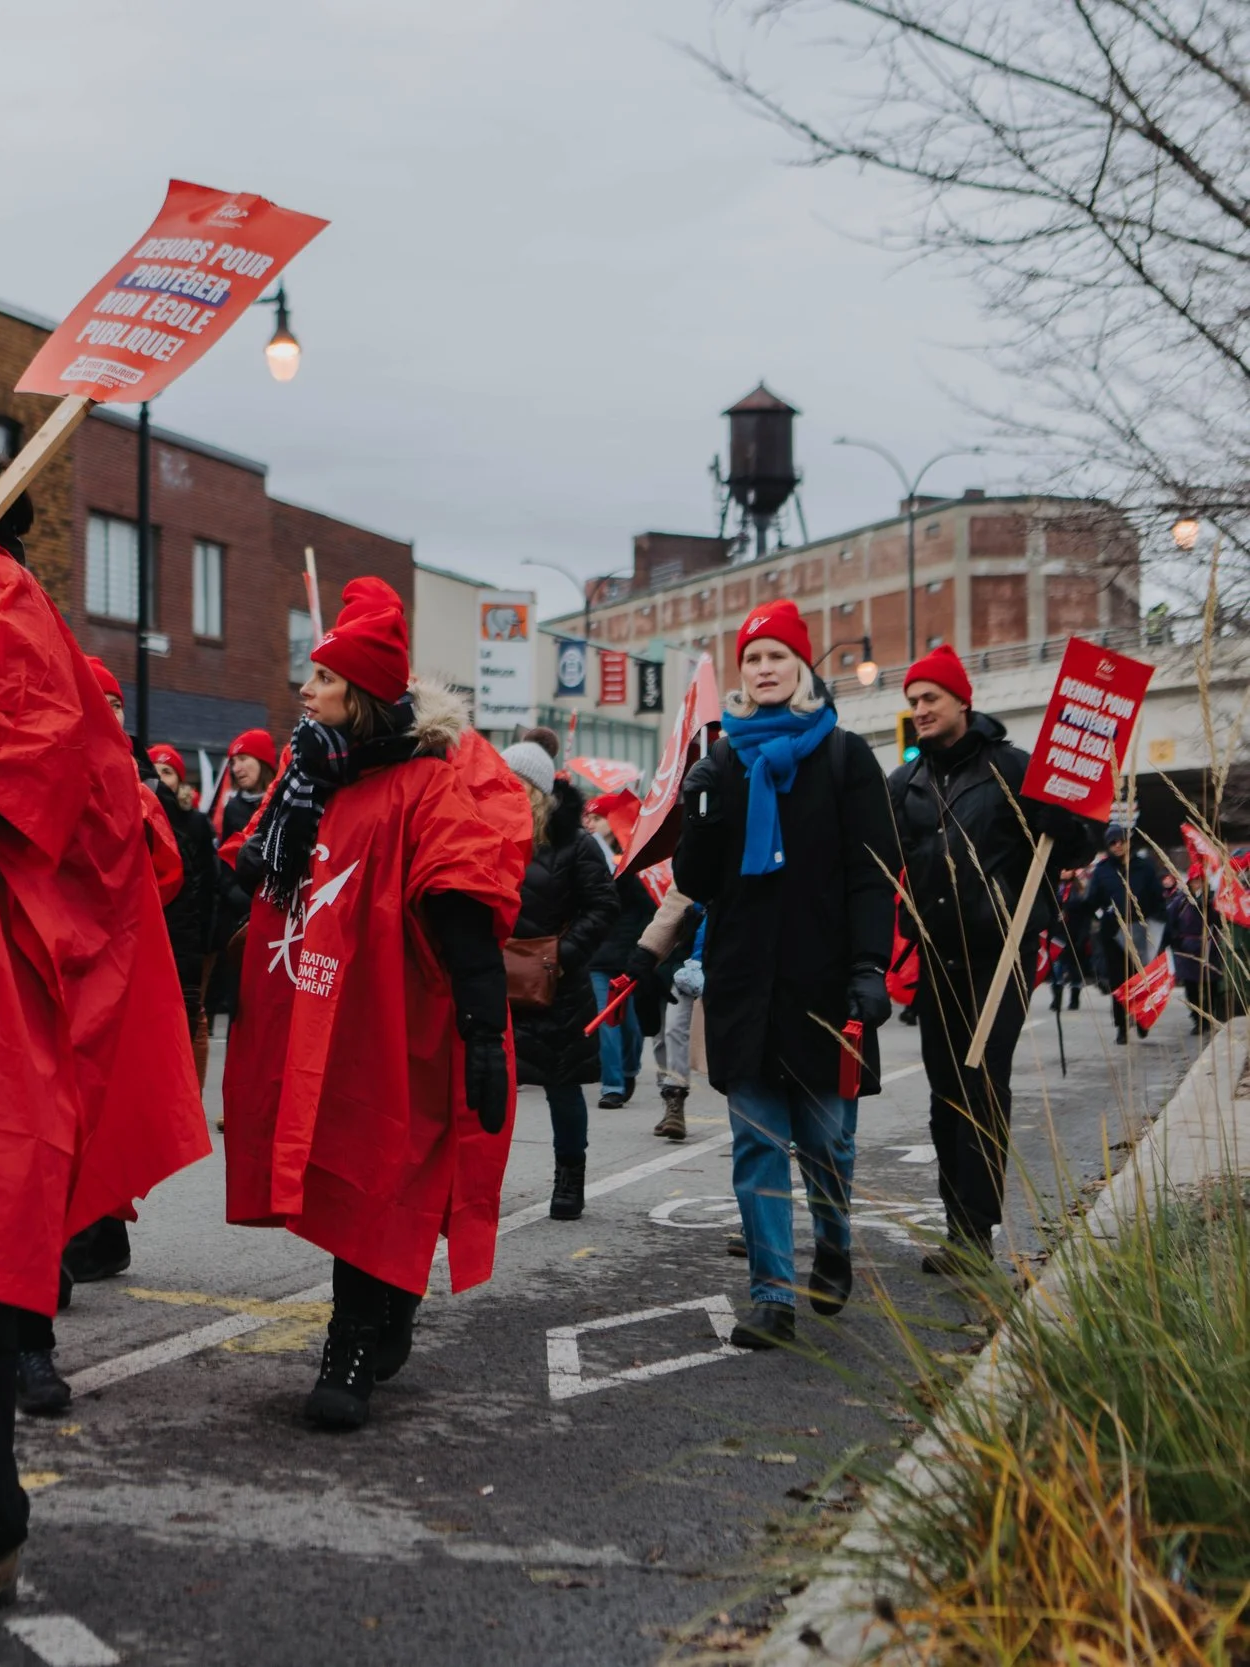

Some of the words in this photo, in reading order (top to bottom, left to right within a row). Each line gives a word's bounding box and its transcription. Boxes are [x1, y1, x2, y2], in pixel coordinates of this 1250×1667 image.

[134, 237, 214, 264] DEHORS
[207, 243, 274, 279] POUR
[124, 265, 231, 304] PROTÉGER
[94, 291, 150, 317] MON
[143, 293, 216, 335] ÉCOLE
[76, 320, 185, 362] PUBLIQUE!
[644, 666, 661, 707] dyson
[1058, 676, 1105, 709] DEHORS
[1102, 692, 1135, 720] POUR
[1050, 724, 1081, 750] MON
[1061, 701, 1119, 739] PROTÉGER
[1046, 746, 1105, 782] PUBLIQUE!
[320, 970, 335, 985] DE
